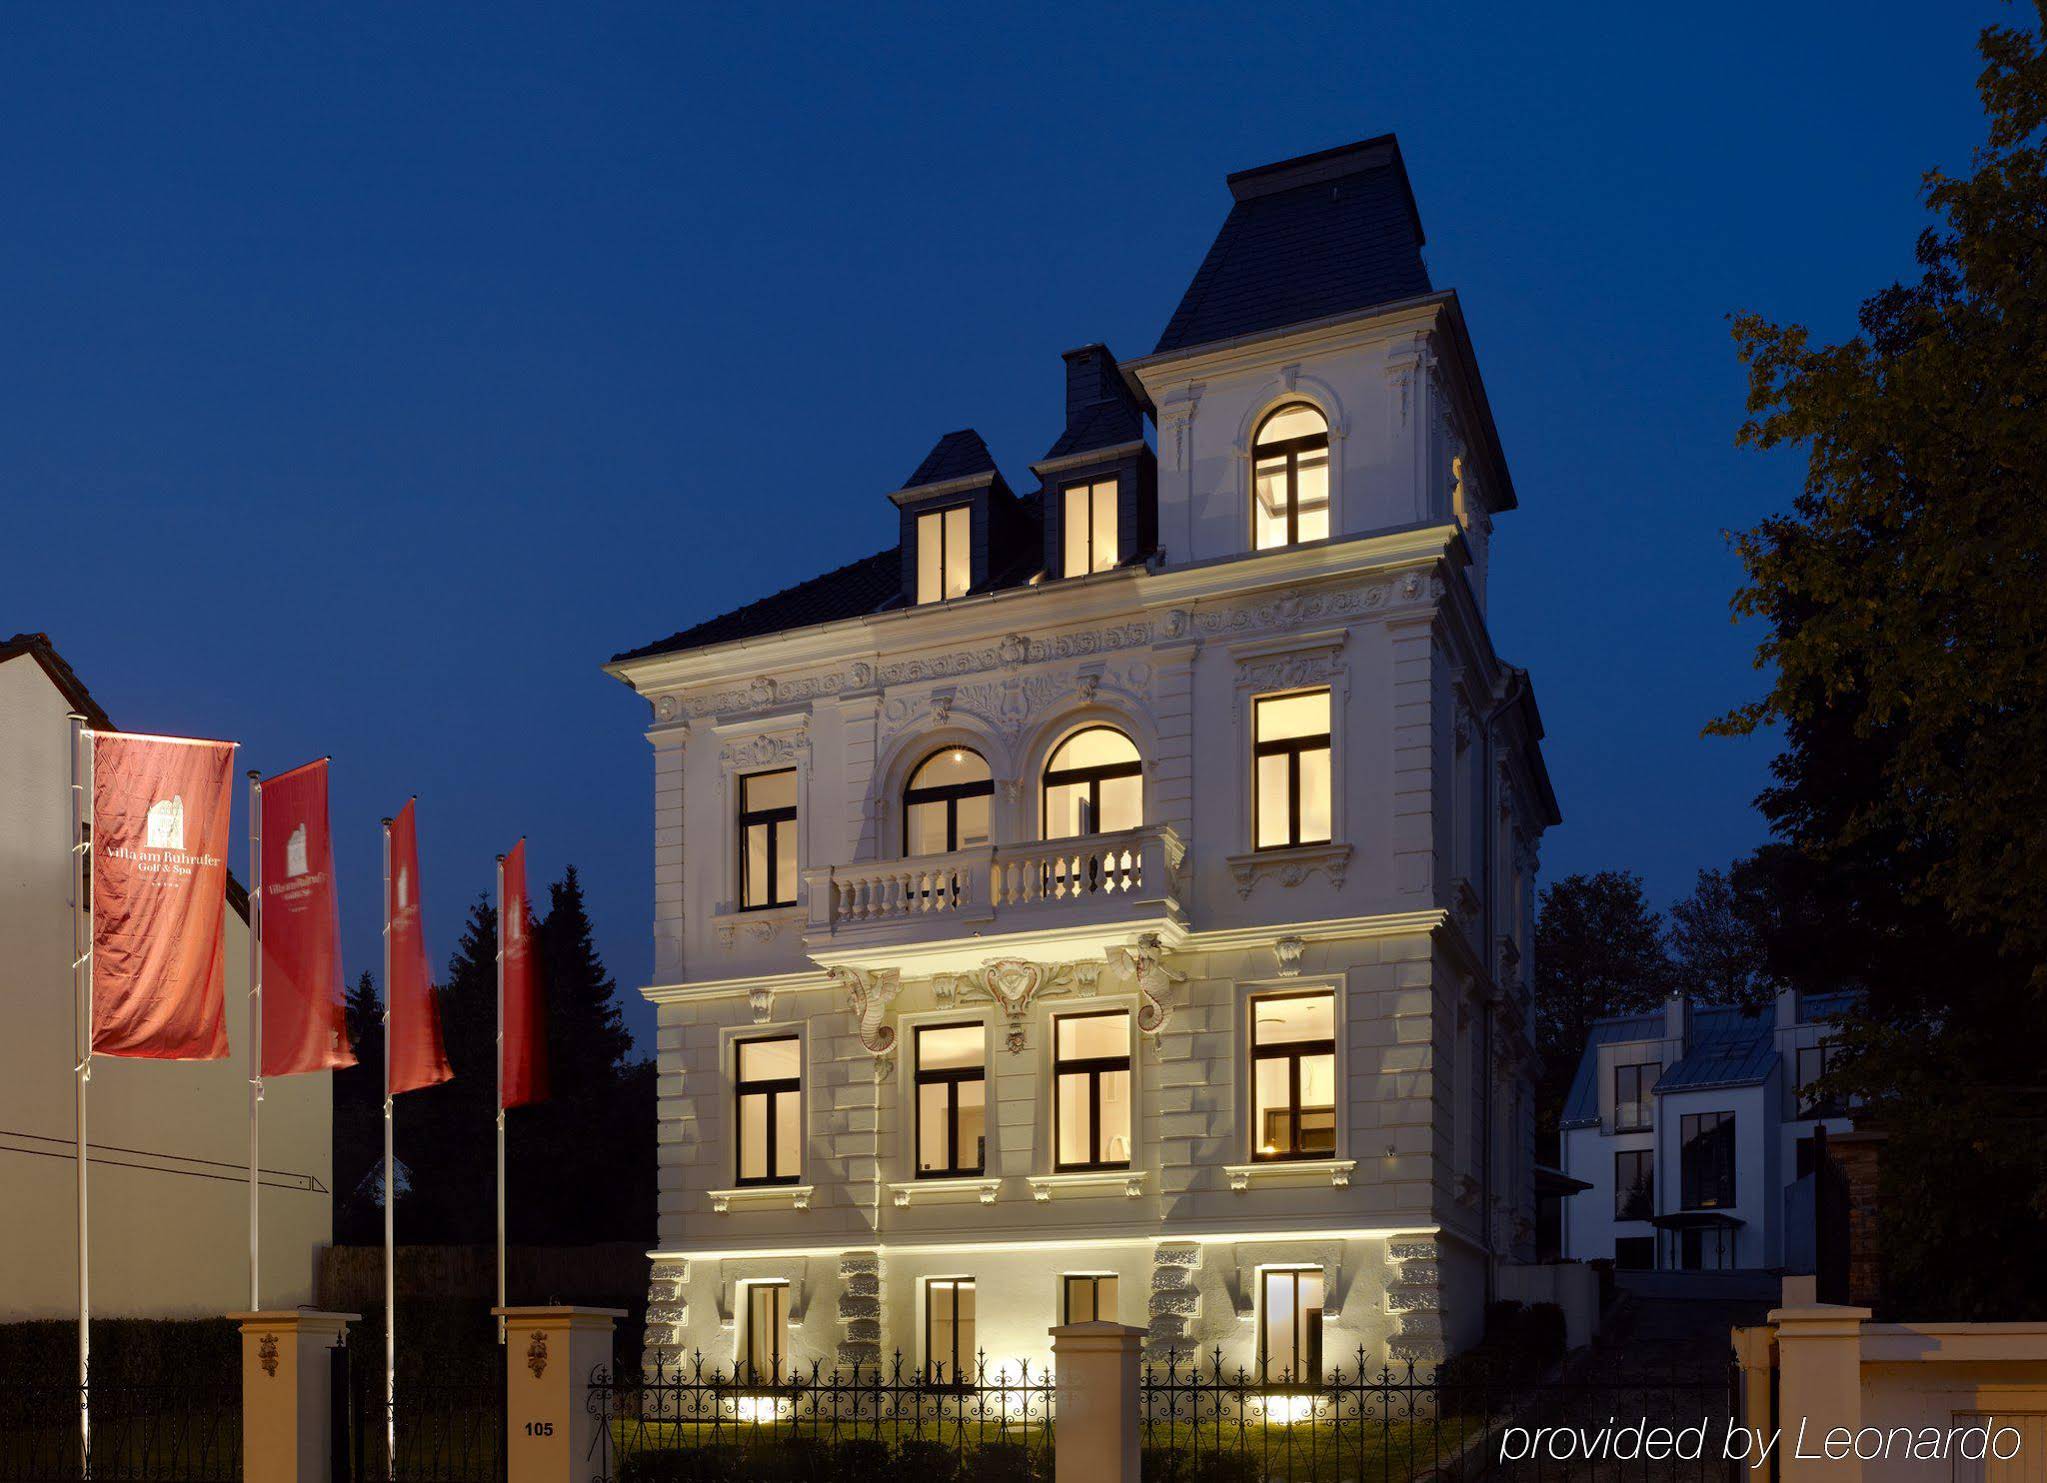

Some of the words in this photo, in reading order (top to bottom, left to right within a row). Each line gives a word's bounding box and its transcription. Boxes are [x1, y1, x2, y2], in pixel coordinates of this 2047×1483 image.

[107, 846, 136, 860] Villa
[140, 852, 160, 861] am
[163, 851, 221, 867] Ruhrufer
[137, 863, 161, 872] Golf
[162, 864, 170, 872] &
[172, 865, 192, 876] Spa
[525, 1422, 553, 1436] 105
